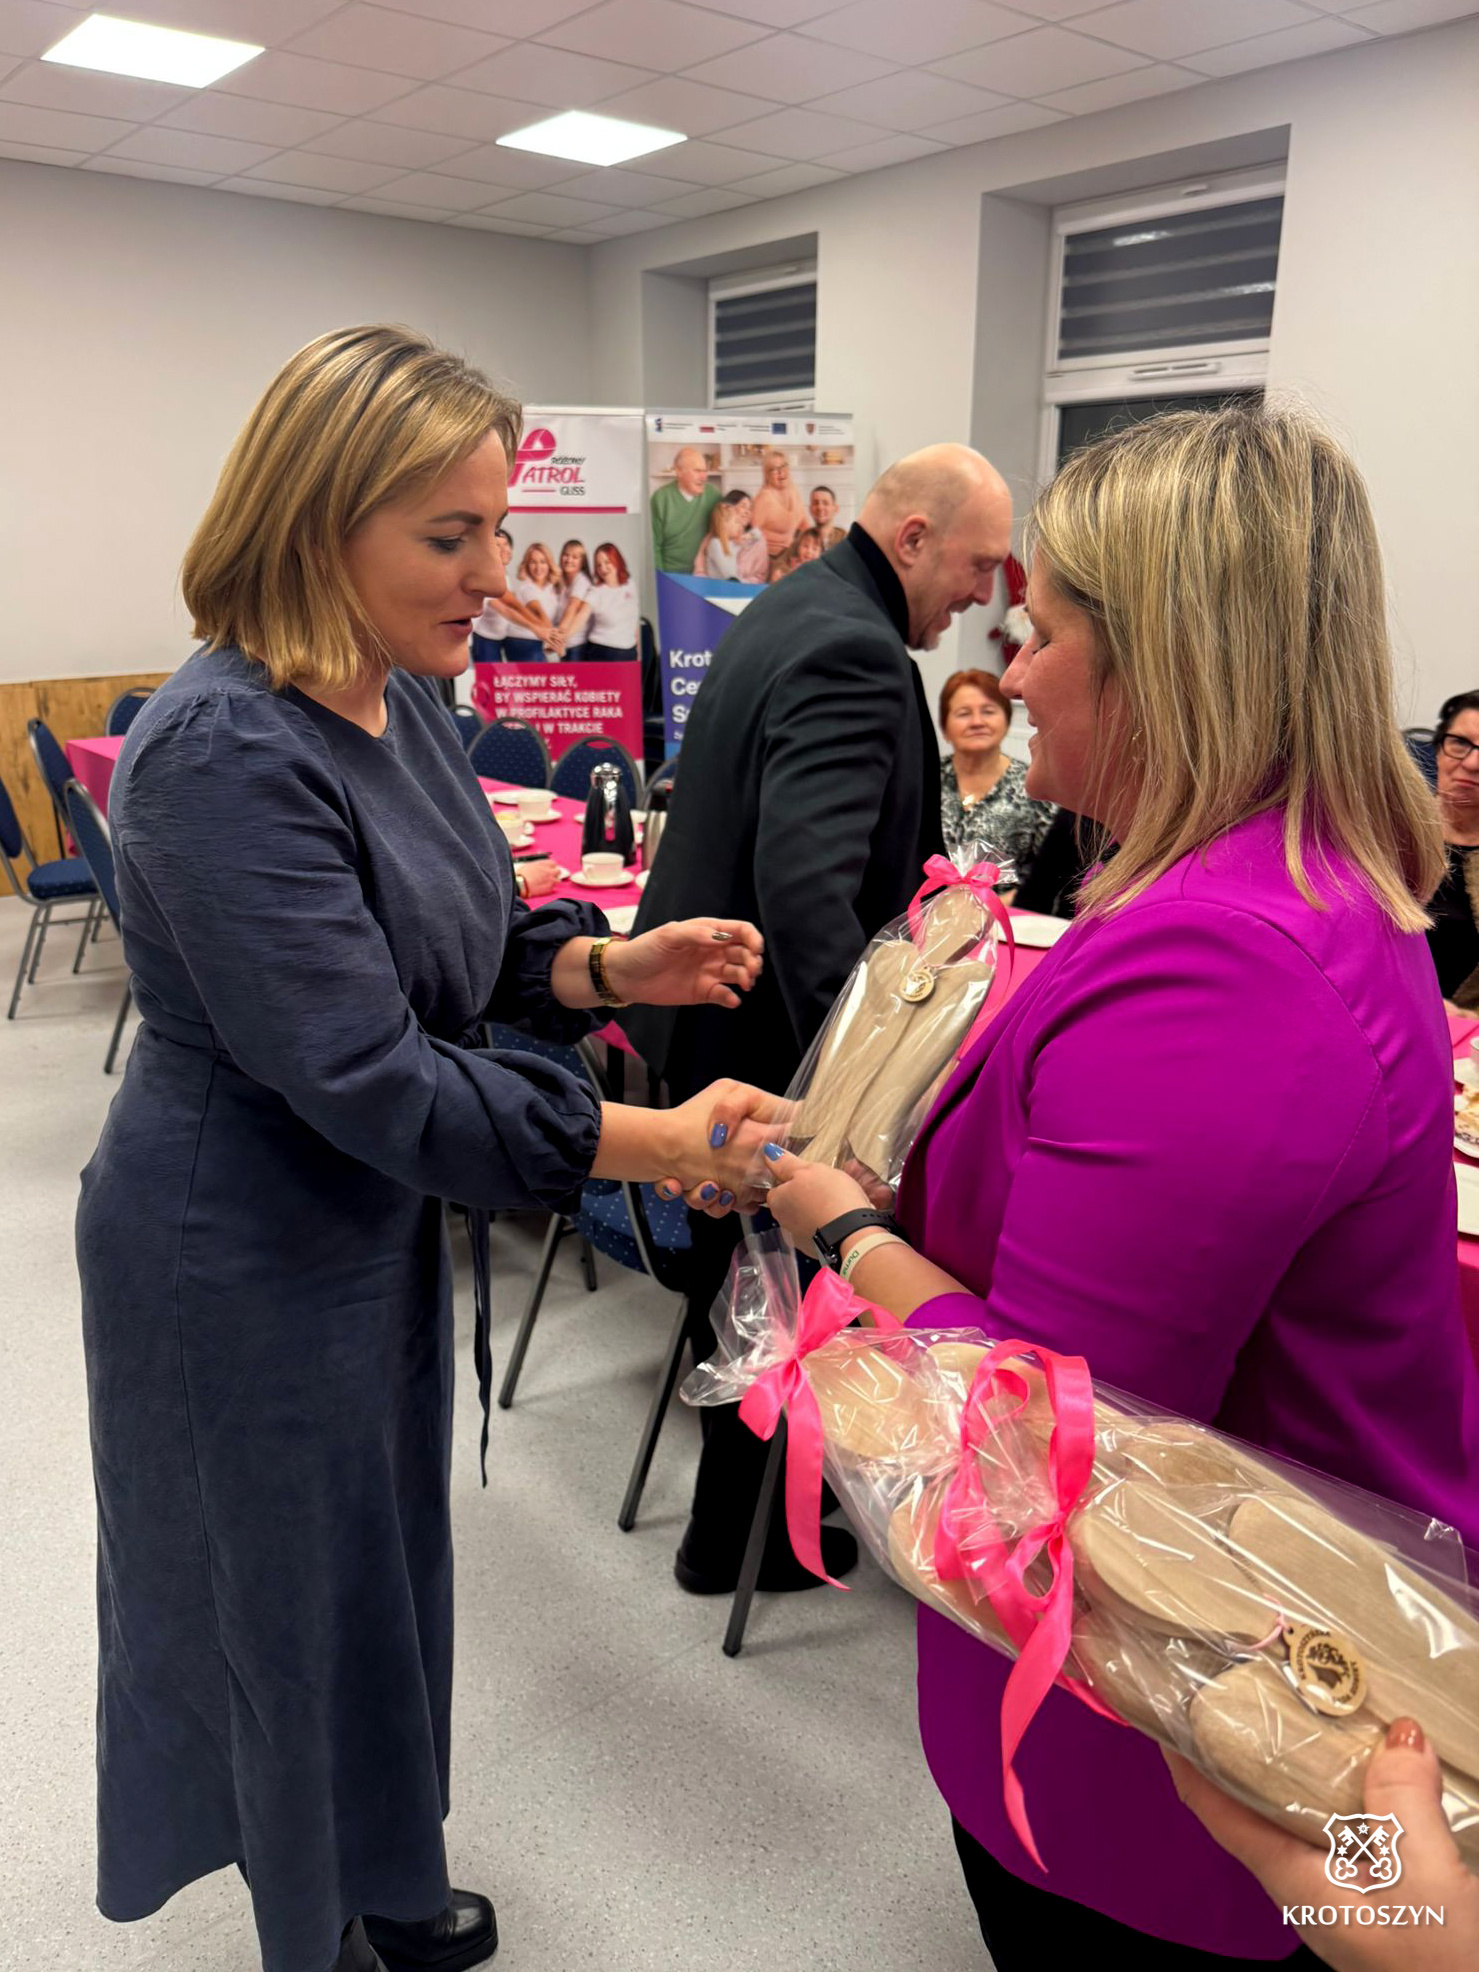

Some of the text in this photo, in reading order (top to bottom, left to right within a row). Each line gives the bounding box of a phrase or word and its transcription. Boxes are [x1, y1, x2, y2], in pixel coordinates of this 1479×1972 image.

[494, 689, 621, 703] BY WSPIERAĆ KOBIETY
[495, 706, 623, 718] W PROFILAKTYCE RAKA
[542, 723, 555, 734] W
[557, 722, 604, 734] TRAKCIE
